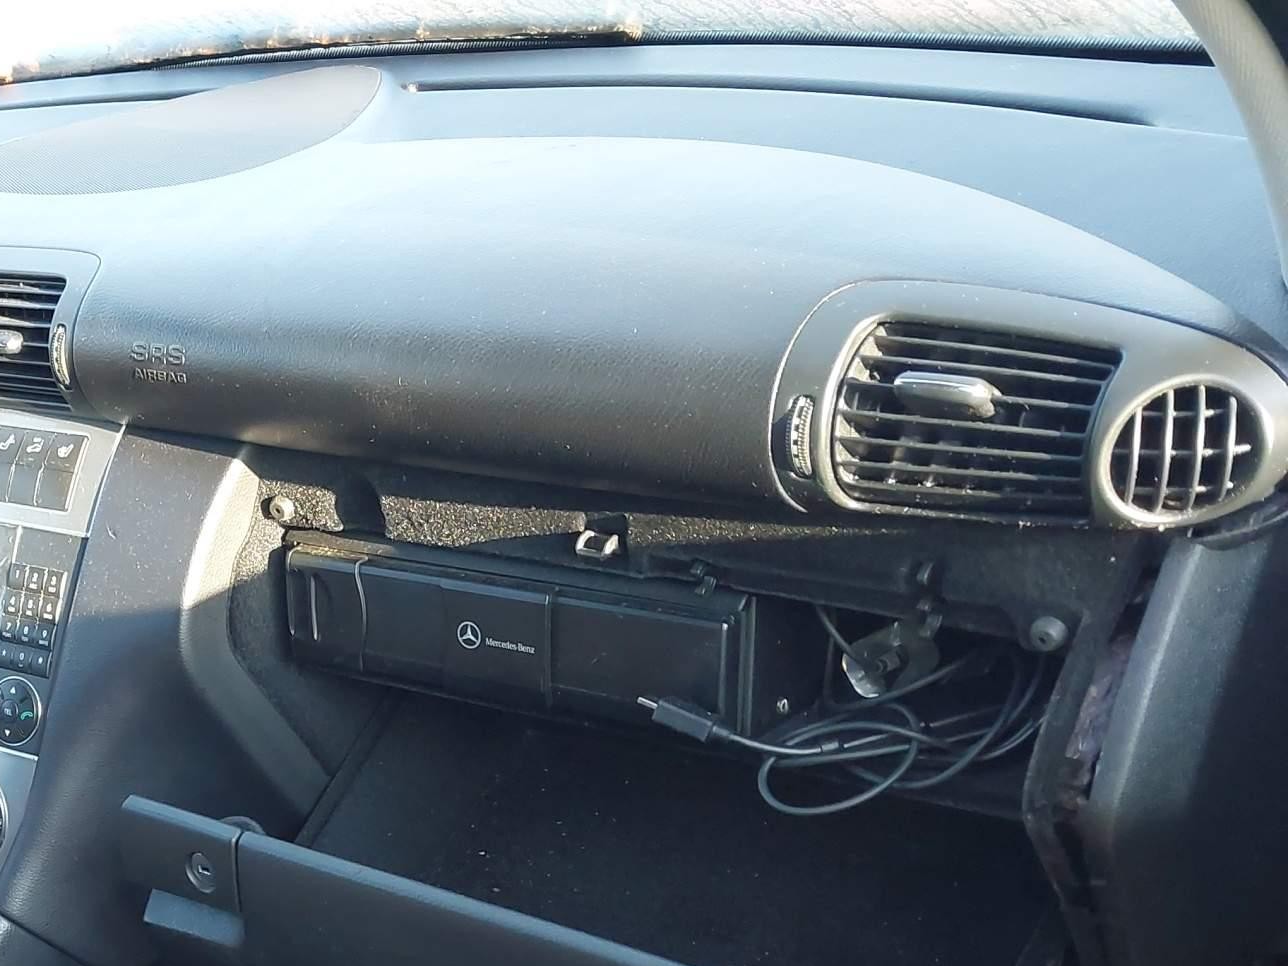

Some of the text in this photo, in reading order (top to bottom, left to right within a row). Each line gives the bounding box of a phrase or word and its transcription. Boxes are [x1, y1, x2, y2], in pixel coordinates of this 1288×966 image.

[131, 341, 186, 365] SRS
[135, 367, 187, 384] AIRBAG
[485, 637, 535, 654] Mercedes-Benz
